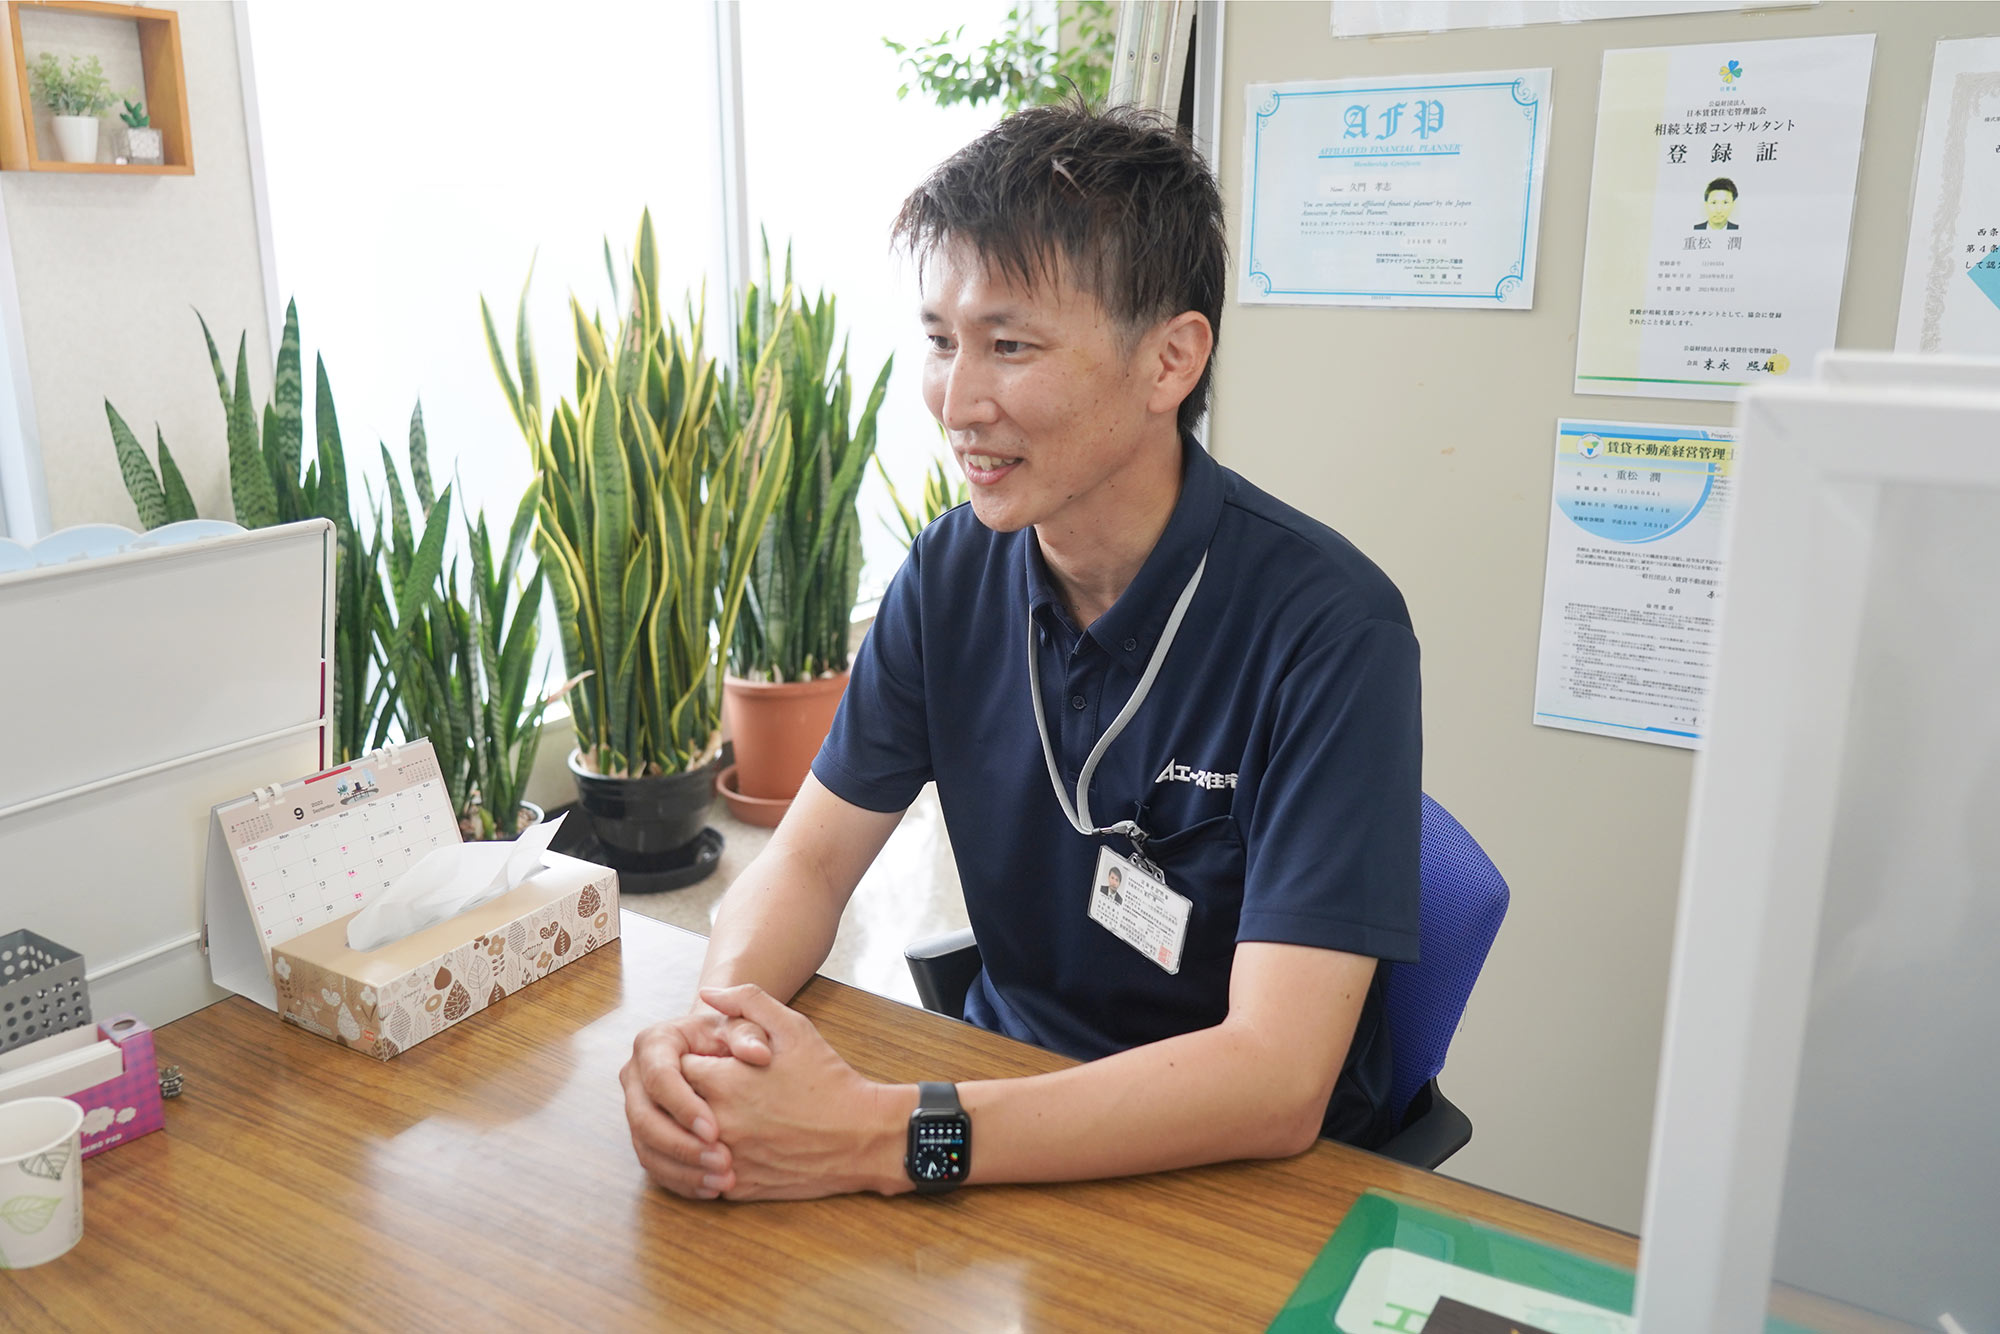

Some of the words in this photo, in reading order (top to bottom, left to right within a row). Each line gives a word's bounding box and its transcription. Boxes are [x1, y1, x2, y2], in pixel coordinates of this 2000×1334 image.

[1687, 106, 1767, 118] 日本賃貸住宅管理協会
[1343, 99, 1445, 141] AFP
[1654, 119, 1796, 136] 相続支援コンサルタント
[1683, 236, 1712, 250] 重松
[1727, 236, 1742, 250] 潤
[1965, 260, 2000, 269] して認
[1616, 469, 1639, 481] 重松
[293, 807, 305, 820] 9
